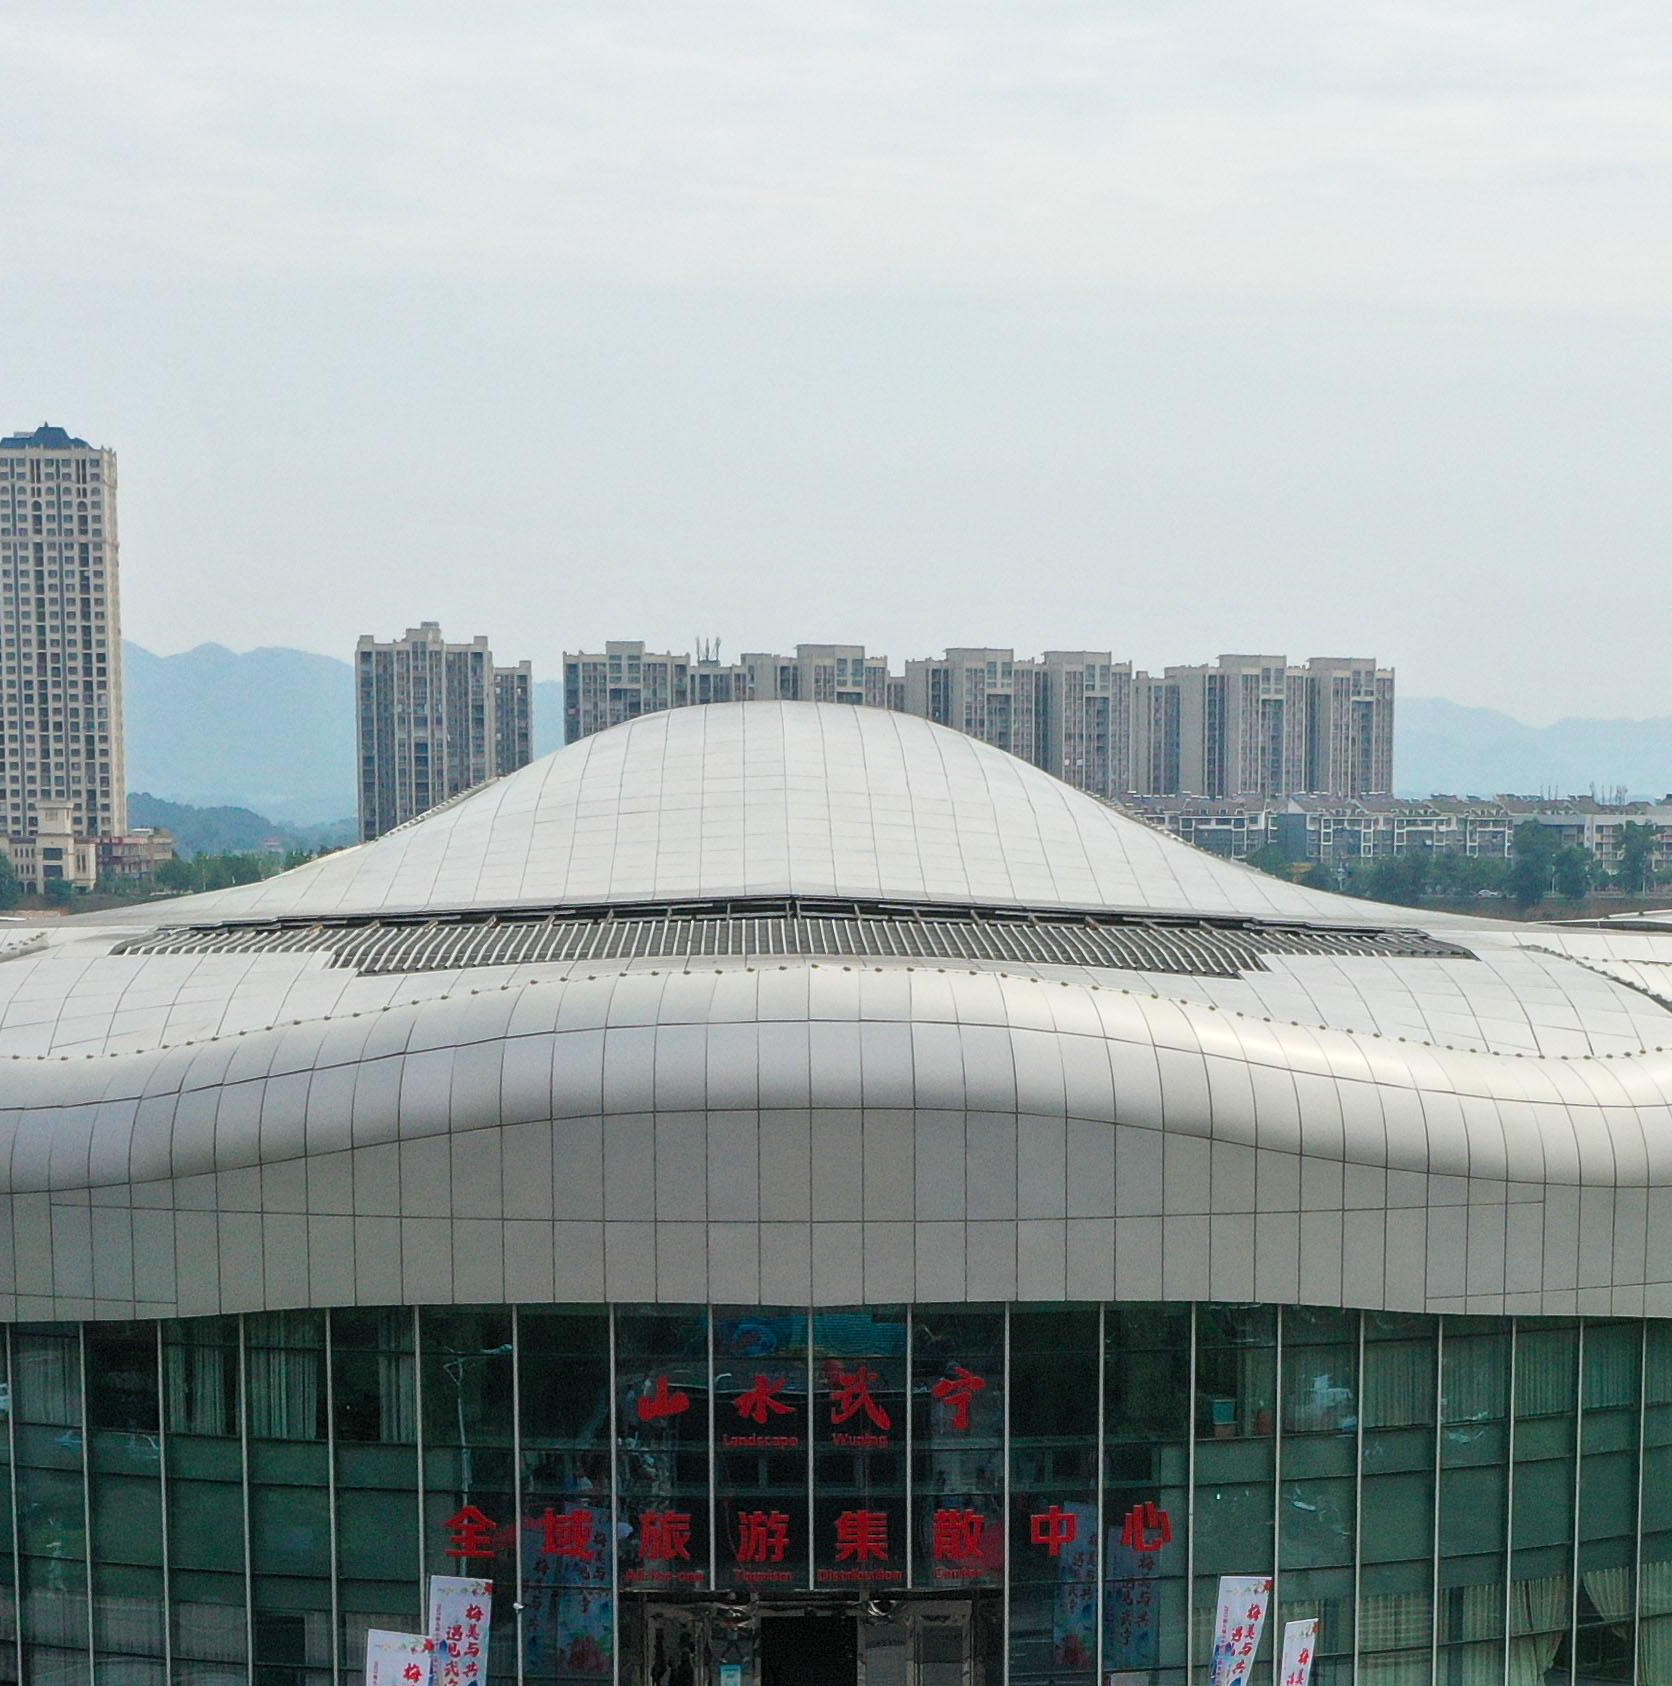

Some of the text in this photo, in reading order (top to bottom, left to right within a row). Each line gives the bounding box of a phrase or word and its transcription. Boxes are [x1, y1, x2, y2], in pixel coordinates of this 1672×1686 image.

[638, 1364, 987, 1430] 山水武宁
[831, 1433, 889, 1448] Wuning
[444, 1501, 1173, 1562] 全域旅游集散中心
